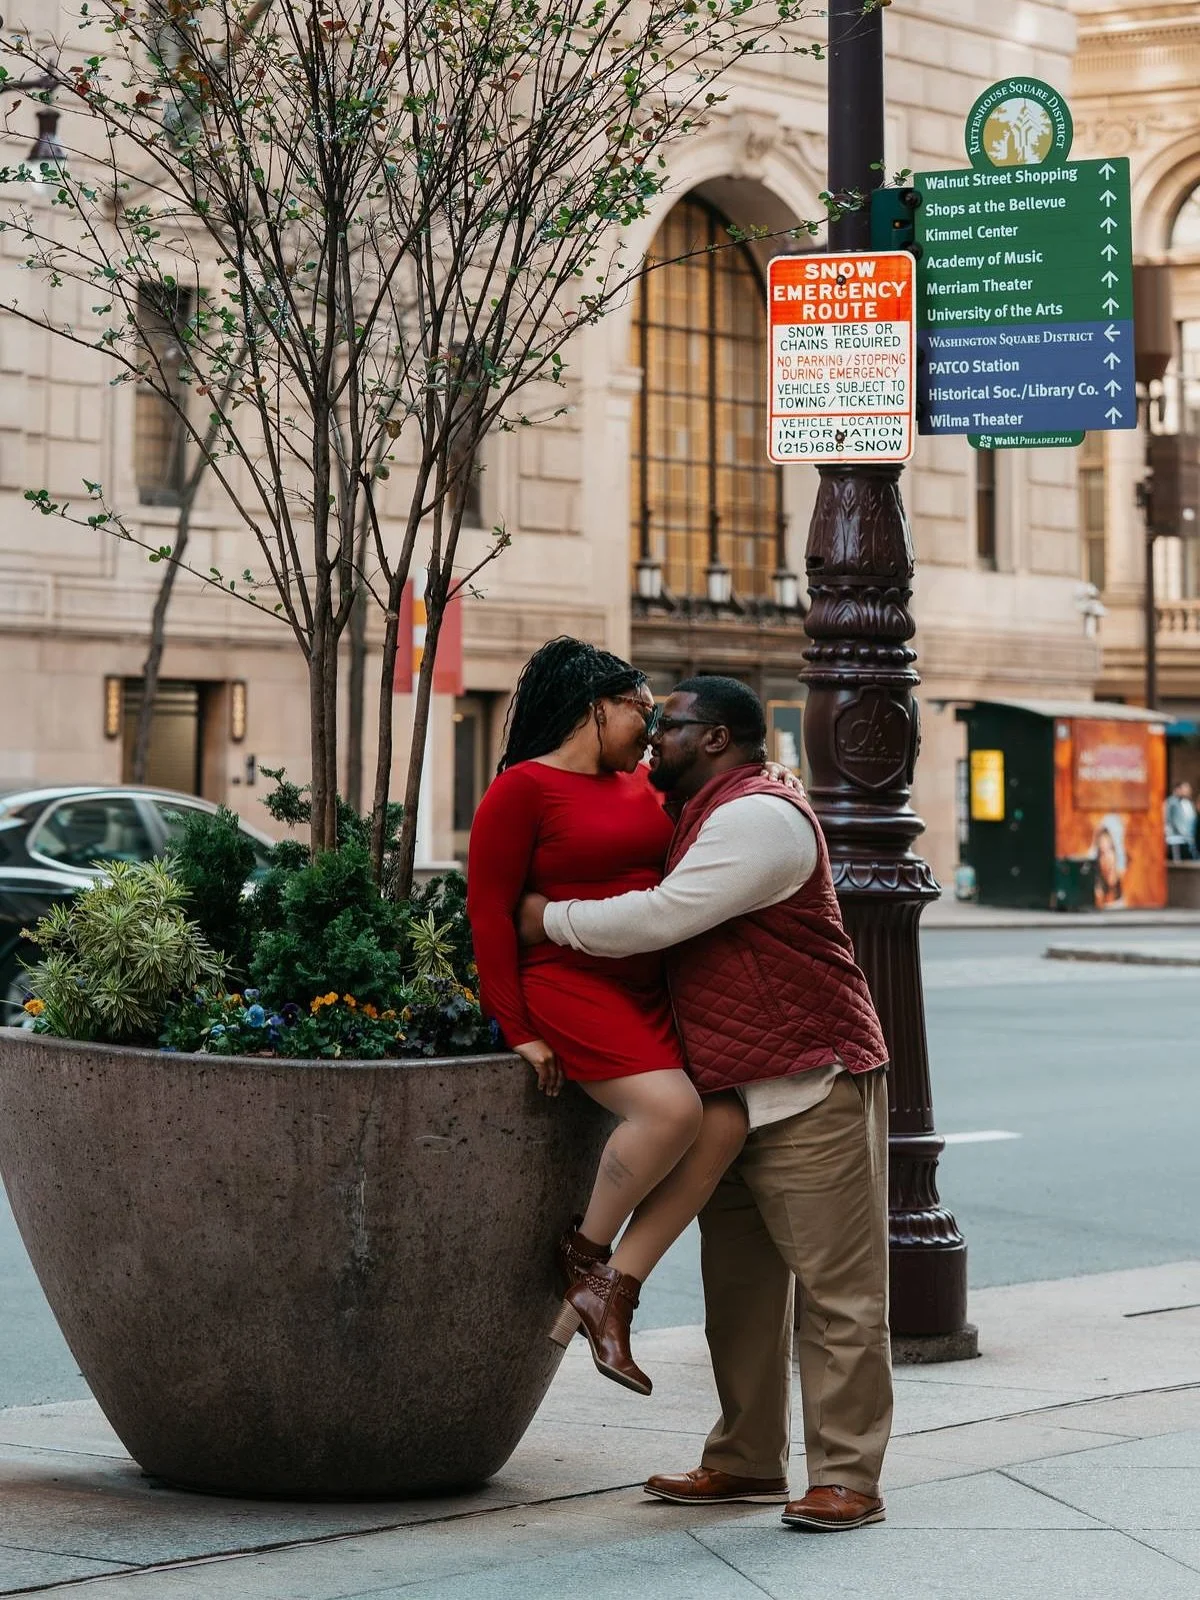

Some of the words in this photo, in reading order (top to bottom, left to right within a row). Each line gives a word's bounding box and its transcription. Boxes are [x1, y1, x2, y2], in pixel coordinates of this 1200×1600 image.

[970, 86, 1009, 155] RITTENHOUSE
[1009, 81, 1049, 101] SQUARE
[1046, 96, 1066, 149] DISTRICT
[925, 175, 970, 190] Walnut
[972, 173, 1012, 187] Street
[1015, 167, 1078, 185] Shopping
[925, 203, 965, 218] Shops
[968, 203, 981, 214] at
[984, 200, 1006, 213] the
[1009, 196, 1067, 211] Bellevue
[925, 226, 973, 241] Kimmel
[977, 225, 1019, 238] Center
[926, 254, 985, 269] Academy
[987, 251, 1001, 265] of
[1004, 250, 1043, 264] Music
[804, 261, 877, 280] SNOW
[773, 281, 907, 301] EMERGENCY
[926, 280, 979, 295] Merriam
[982, 278, 1033, 292] Theater
[802, 301, 878, 320] ROUTE
[927, 306, 991, 322] University
[994, 304, 1008, 318] of
[1010, 303, 1032, 317] the
[1035, 303, 1063, 316] Arts
[788, 326, 825, 338] SNOW
[832, 324, 869, 336] TIRES
[875, 323, 893, 335] OR
[780, 339, 829, 351] CHAINS
[835, 336, 901, 349] REQUIRED
[928, 336, 997, 348] WASHINGTON
[999, 333, 1041, 346] SQUARE
[1043, 331, 1094, 343] DISTRICT
[777, 356, 792, 367] NO
[929, 361, 969, 375] PATCO
[972, 358, 1020, 373] Station
[782, 368, 824, 380] DURING
[829, 366, 900, 379] EMERGENCY
[777, 383, 830, 395] VEHICLES
[836, 381, 886, 393] SUBJECT
[892, 380, 905, 392] TO
[929, 385, 990, 401] Historical
[1078, 382, 1099, 396] Co.
[781, 418, 833, 428] VEHICLE
[841, 416, 902, 427] LOCATION
[929, 413, 970, 428] Wilma
[973, 413, 1024, 426] Theater
[777, 440, 902, 455] (215)686-SNOW
